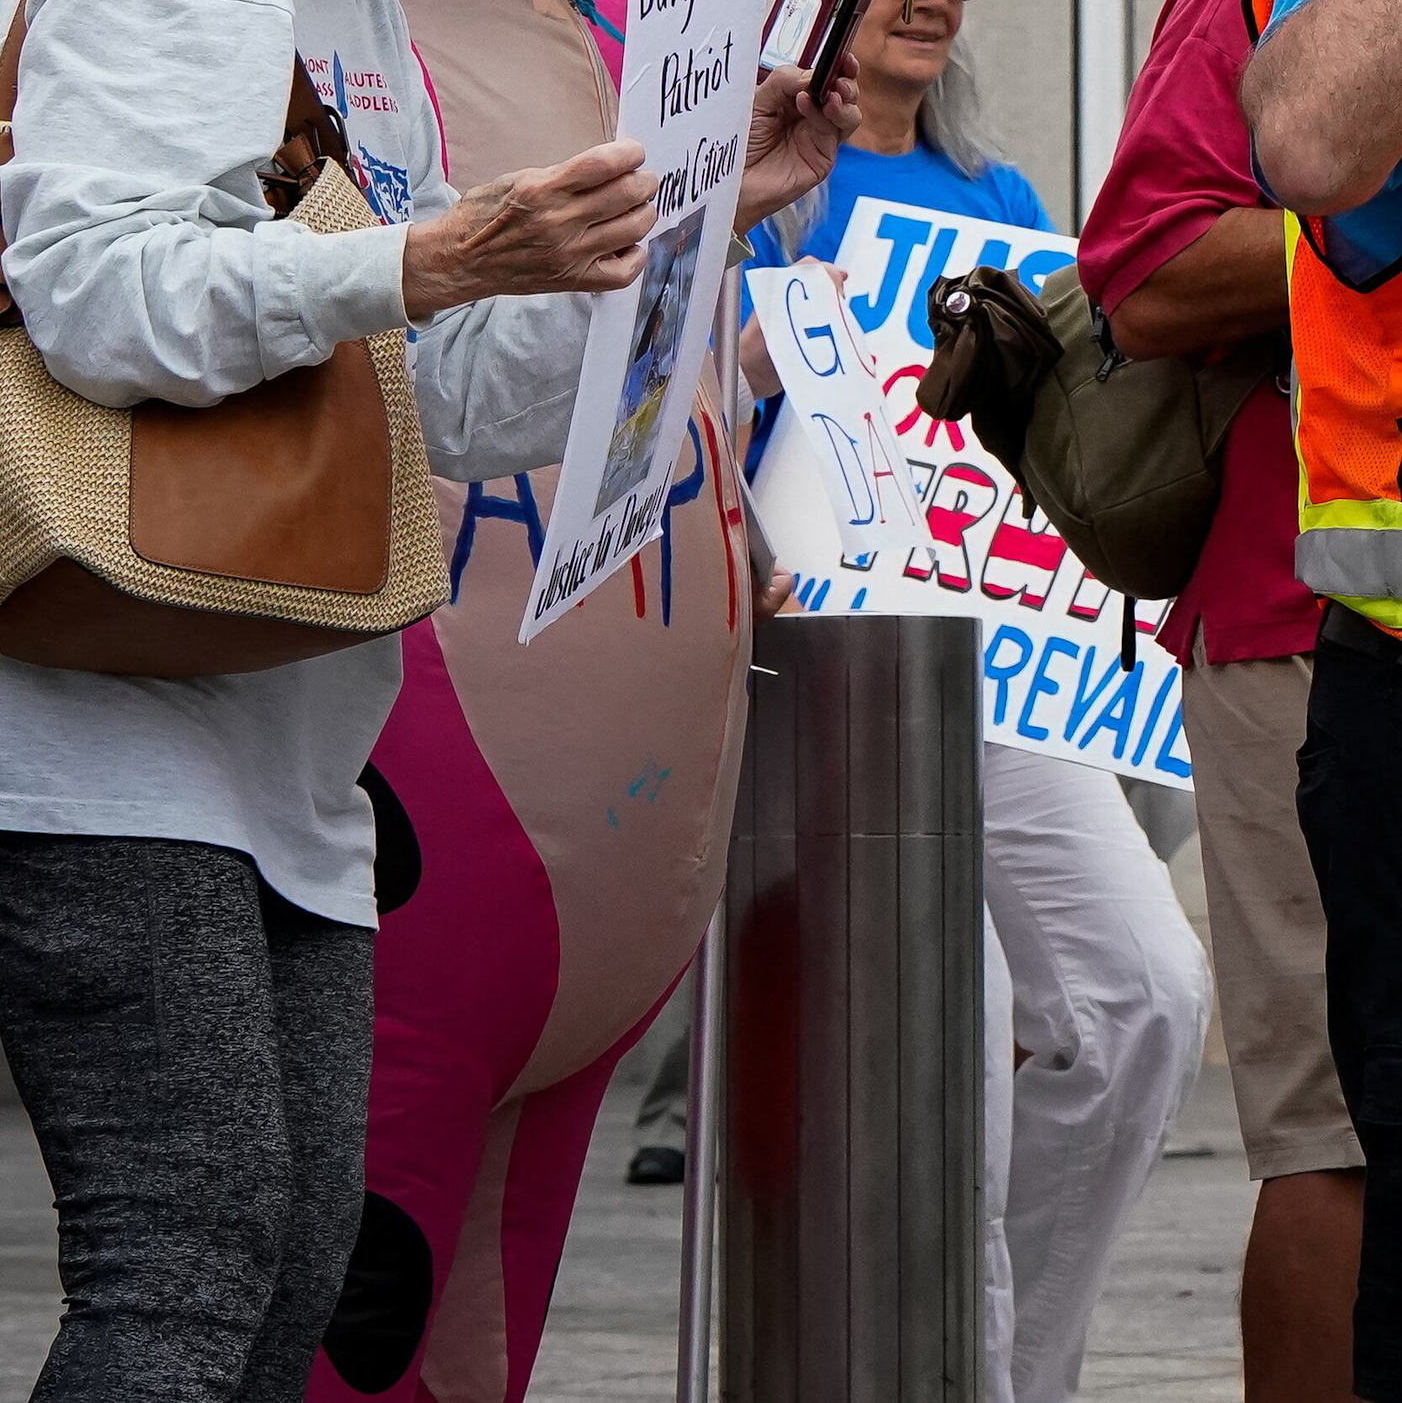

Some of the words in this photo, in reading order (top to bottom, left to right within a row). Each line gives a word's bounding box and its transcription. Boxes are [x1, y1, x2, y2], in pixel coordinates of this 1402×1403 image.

[304, 58, 329, 75] ONT
[344, 71, 387, 88] ALUTES
[315, 81, 334, 97] ASS
[347, 94, 398, 113] ADDLERS
[661, 31, 734, 128] Patriot
[656, 149, 689, 217] rned
[691, 134, 738, 203] Citizen
[535, 539, 594, 620] Justice
[590, 514, 618, 576] for
[983, 624, 1193, 778] REVAIL
